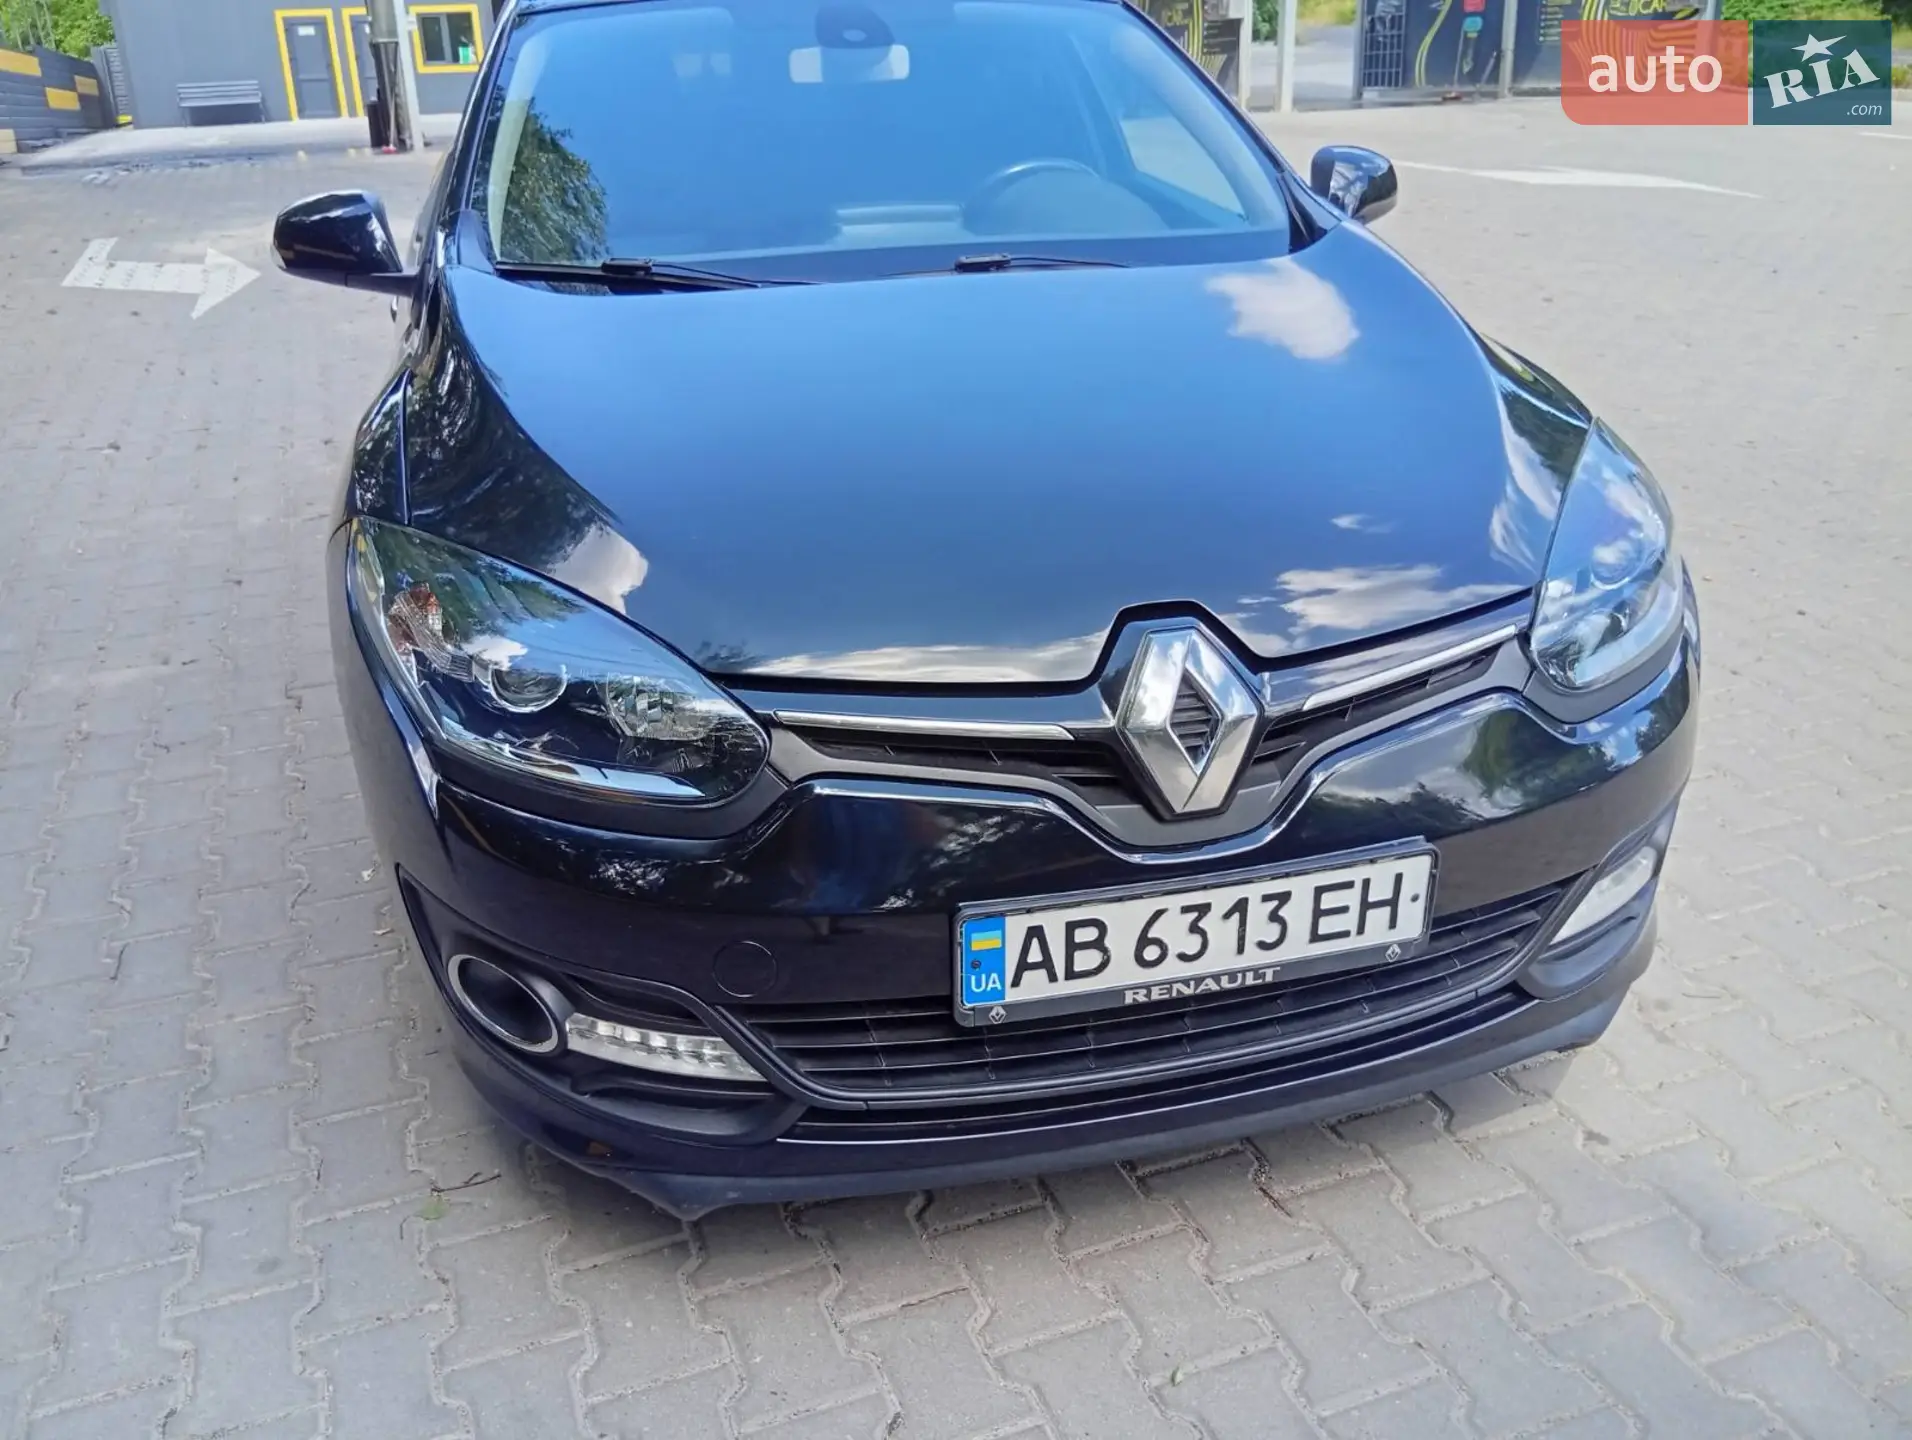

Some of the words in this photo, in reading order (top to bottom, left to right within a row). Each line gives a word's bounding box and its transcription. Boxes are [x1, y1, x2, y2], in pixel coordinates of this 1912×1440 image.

[1010, 918, 1112, 988] AB
[1133, 891, 1293, 968] 6313
[1308, 871, 1403, 944] EH
[970, 973, 1003, 993] UA
[1123, 967, 1281, 1004] RENAULT
